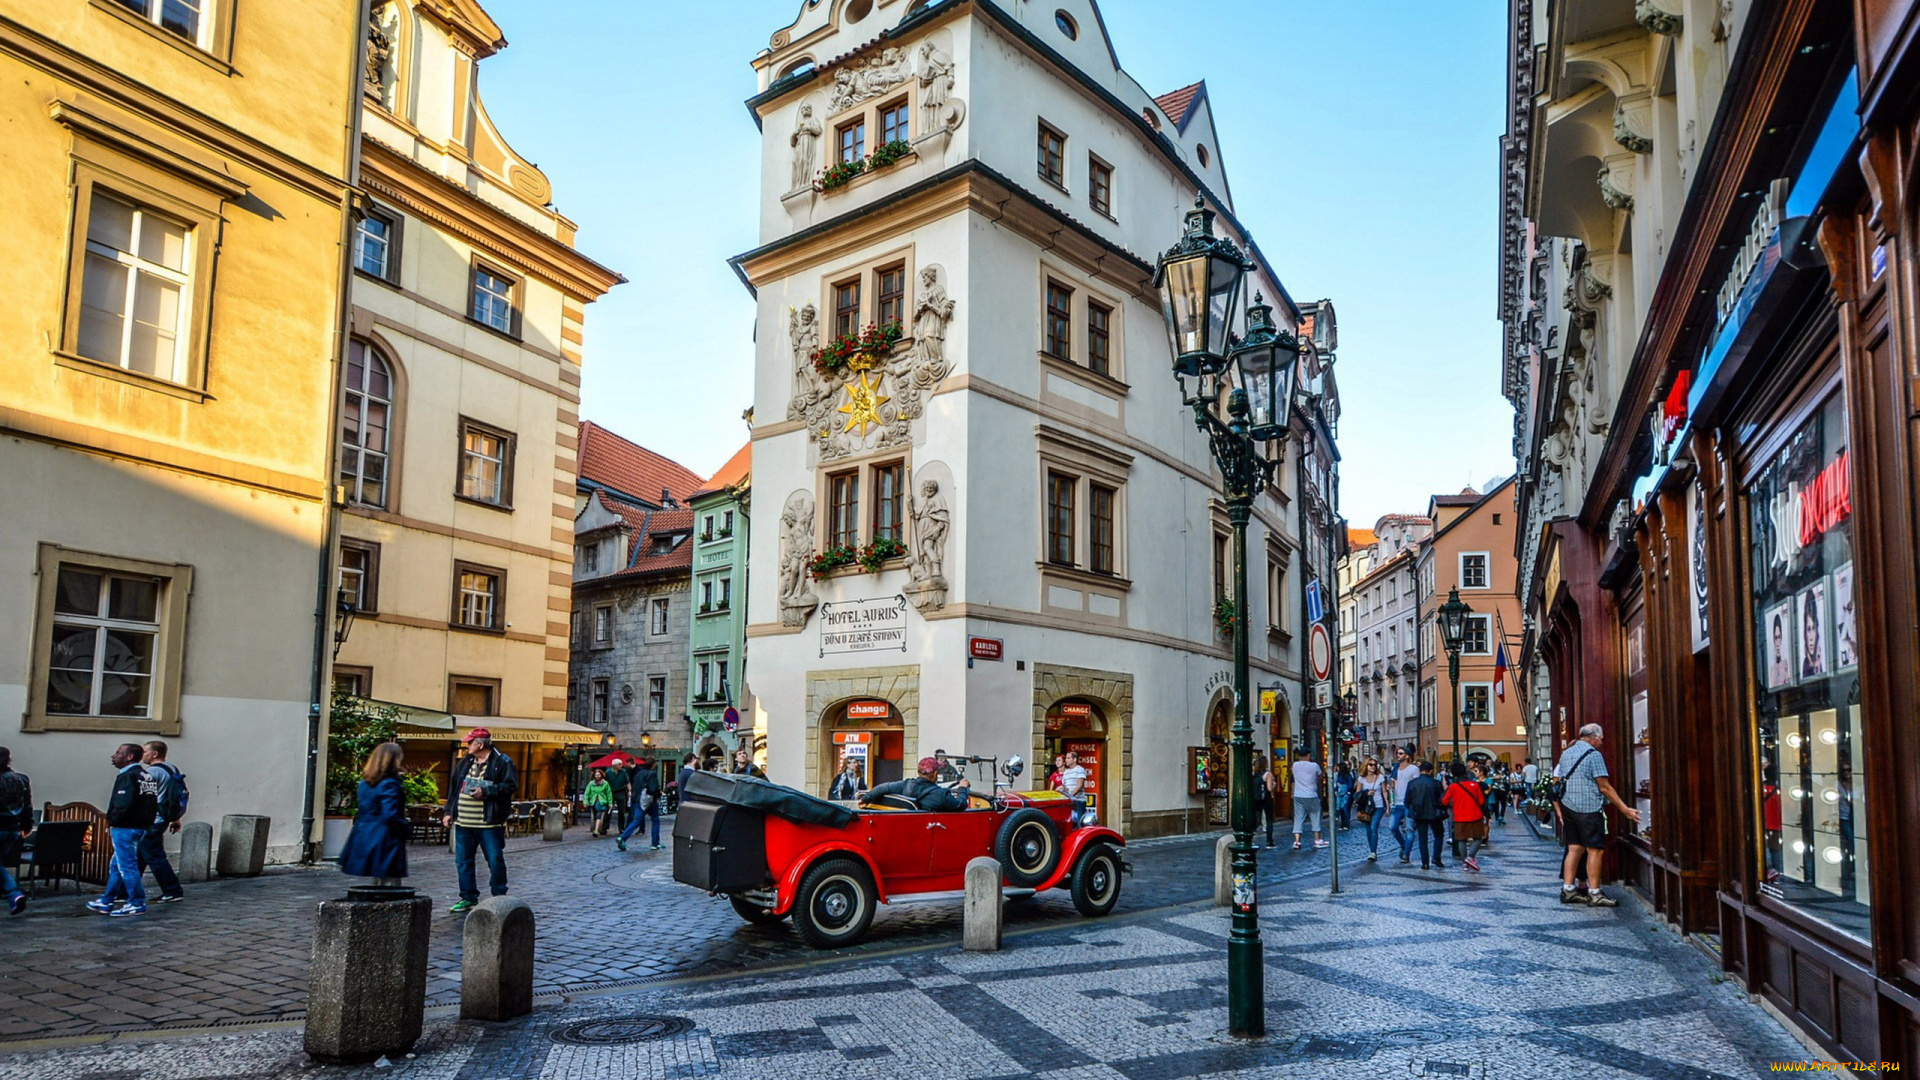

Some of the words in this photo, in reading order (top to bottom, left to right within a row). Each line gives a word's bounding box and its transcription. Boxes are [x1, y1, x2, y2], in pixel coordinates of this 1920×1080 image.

[707, 551, 728, 563] HOTEL
[828, 610, 861, 625] HOTEL
[862, 607, 898, 622] AURUS
[848, 630, 872, 643] ZLATÉ
[975, 642, 998, 650] KARLOVA
[1203, 670, 1235, 696] KERAMI
[850, 705, 886, 715] change
[1063, 706, 1089, 714] CHANGE
[491, 732, 541, 741] RESTAURANT
[553, 734, 594, 743] CLEMENTIN
[844, 734, 859, 743] ATM
[1071, 744, 1096, 752] CHANGE
[1078, 756, 1097, 764] CHSEL
